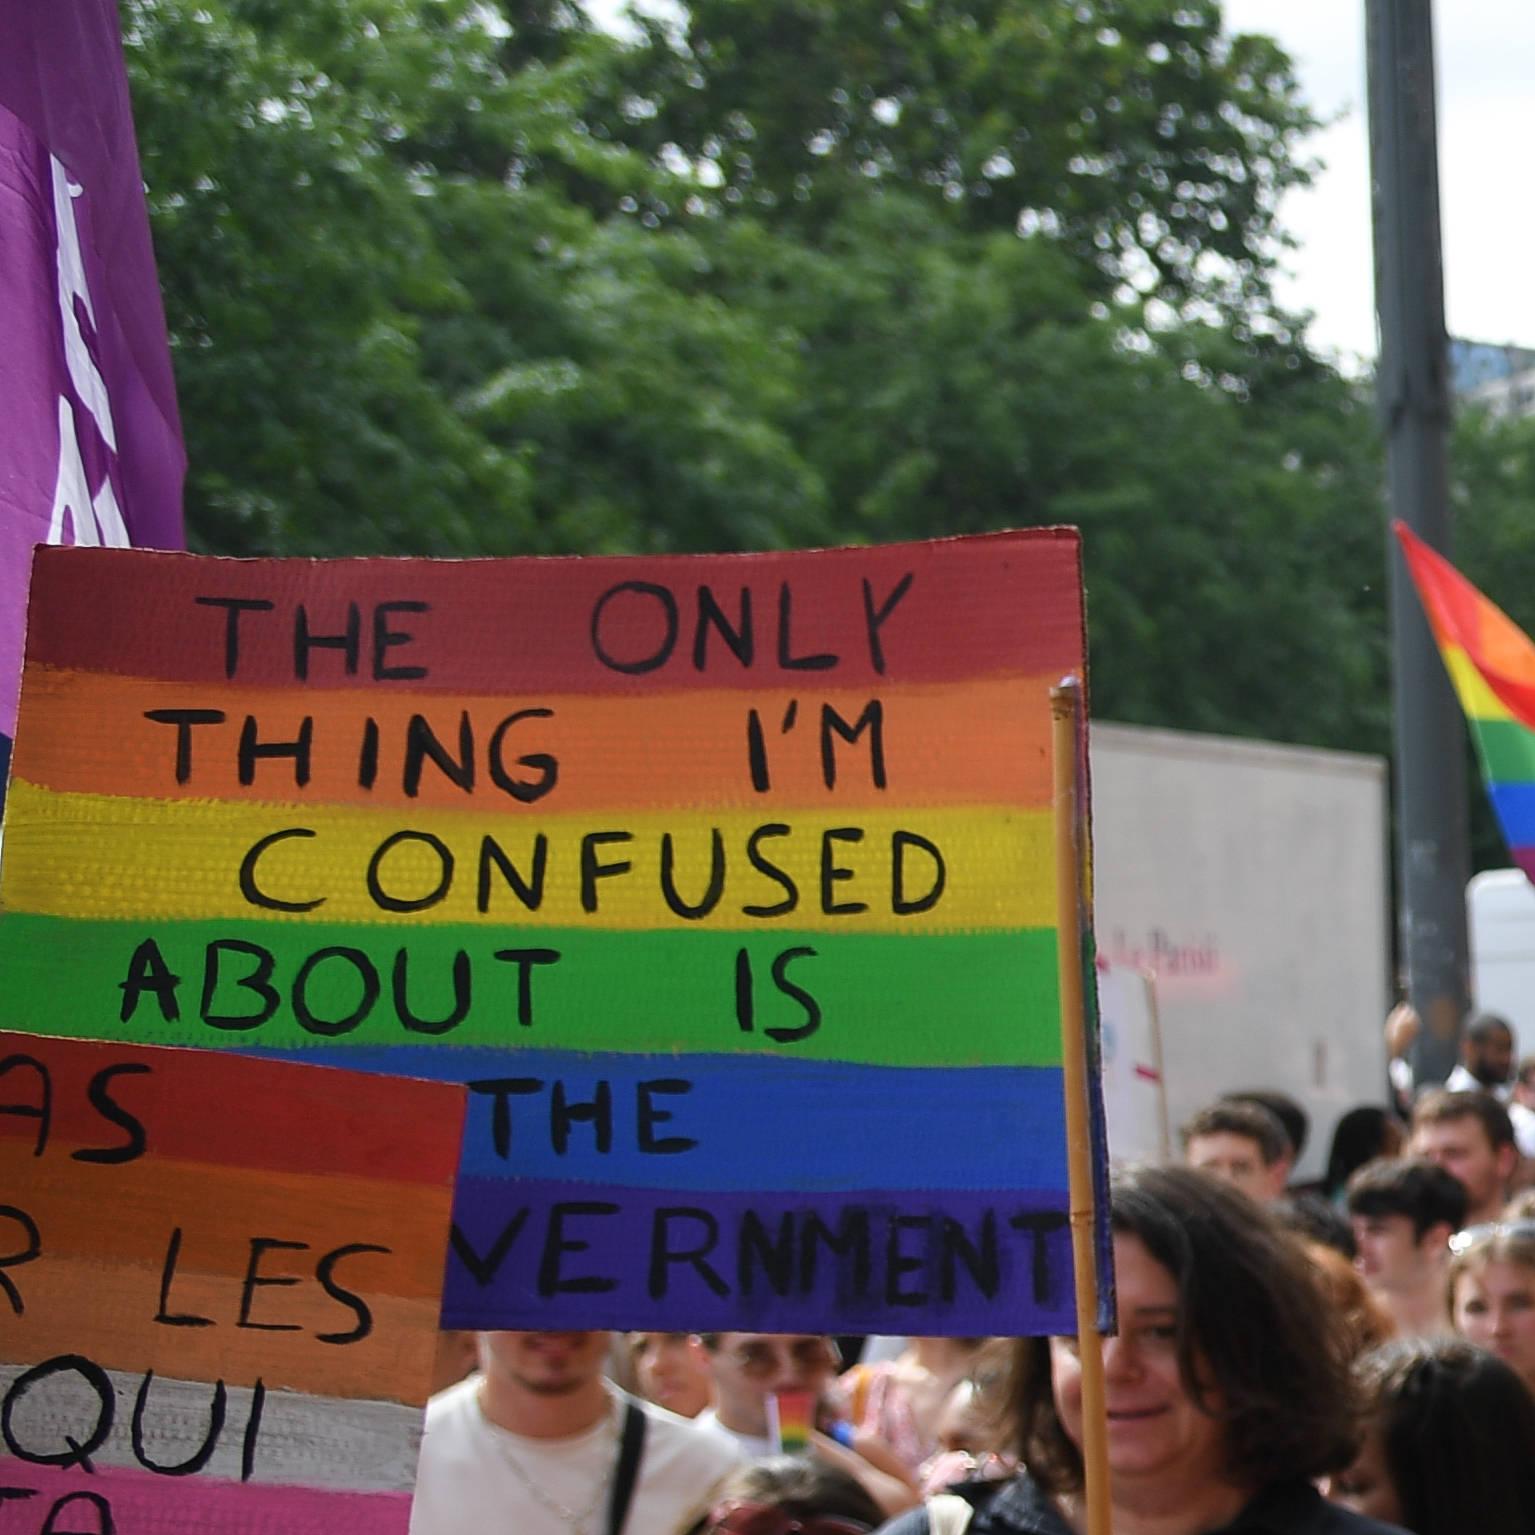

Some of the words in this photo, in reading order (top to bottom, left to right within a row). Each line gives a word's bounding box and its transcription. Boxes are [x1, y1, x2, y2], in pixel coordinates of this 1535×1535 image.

[195, 597, 429, 680] THE
[590, 572, 914, 674] ONLY
[144, 708, 559, 801] THING
[748, 699, 888, 792] I'M
[239, 823, 947, 917] CONFUSED
[119, 937, 562, 1037] ABOUT
[735, 946, 822, 1043] IS
[467, 1078, 697, 1159] THE
[154, 1227, 391, 1345] LES
[2, 1354, 265, 1482] QUI
